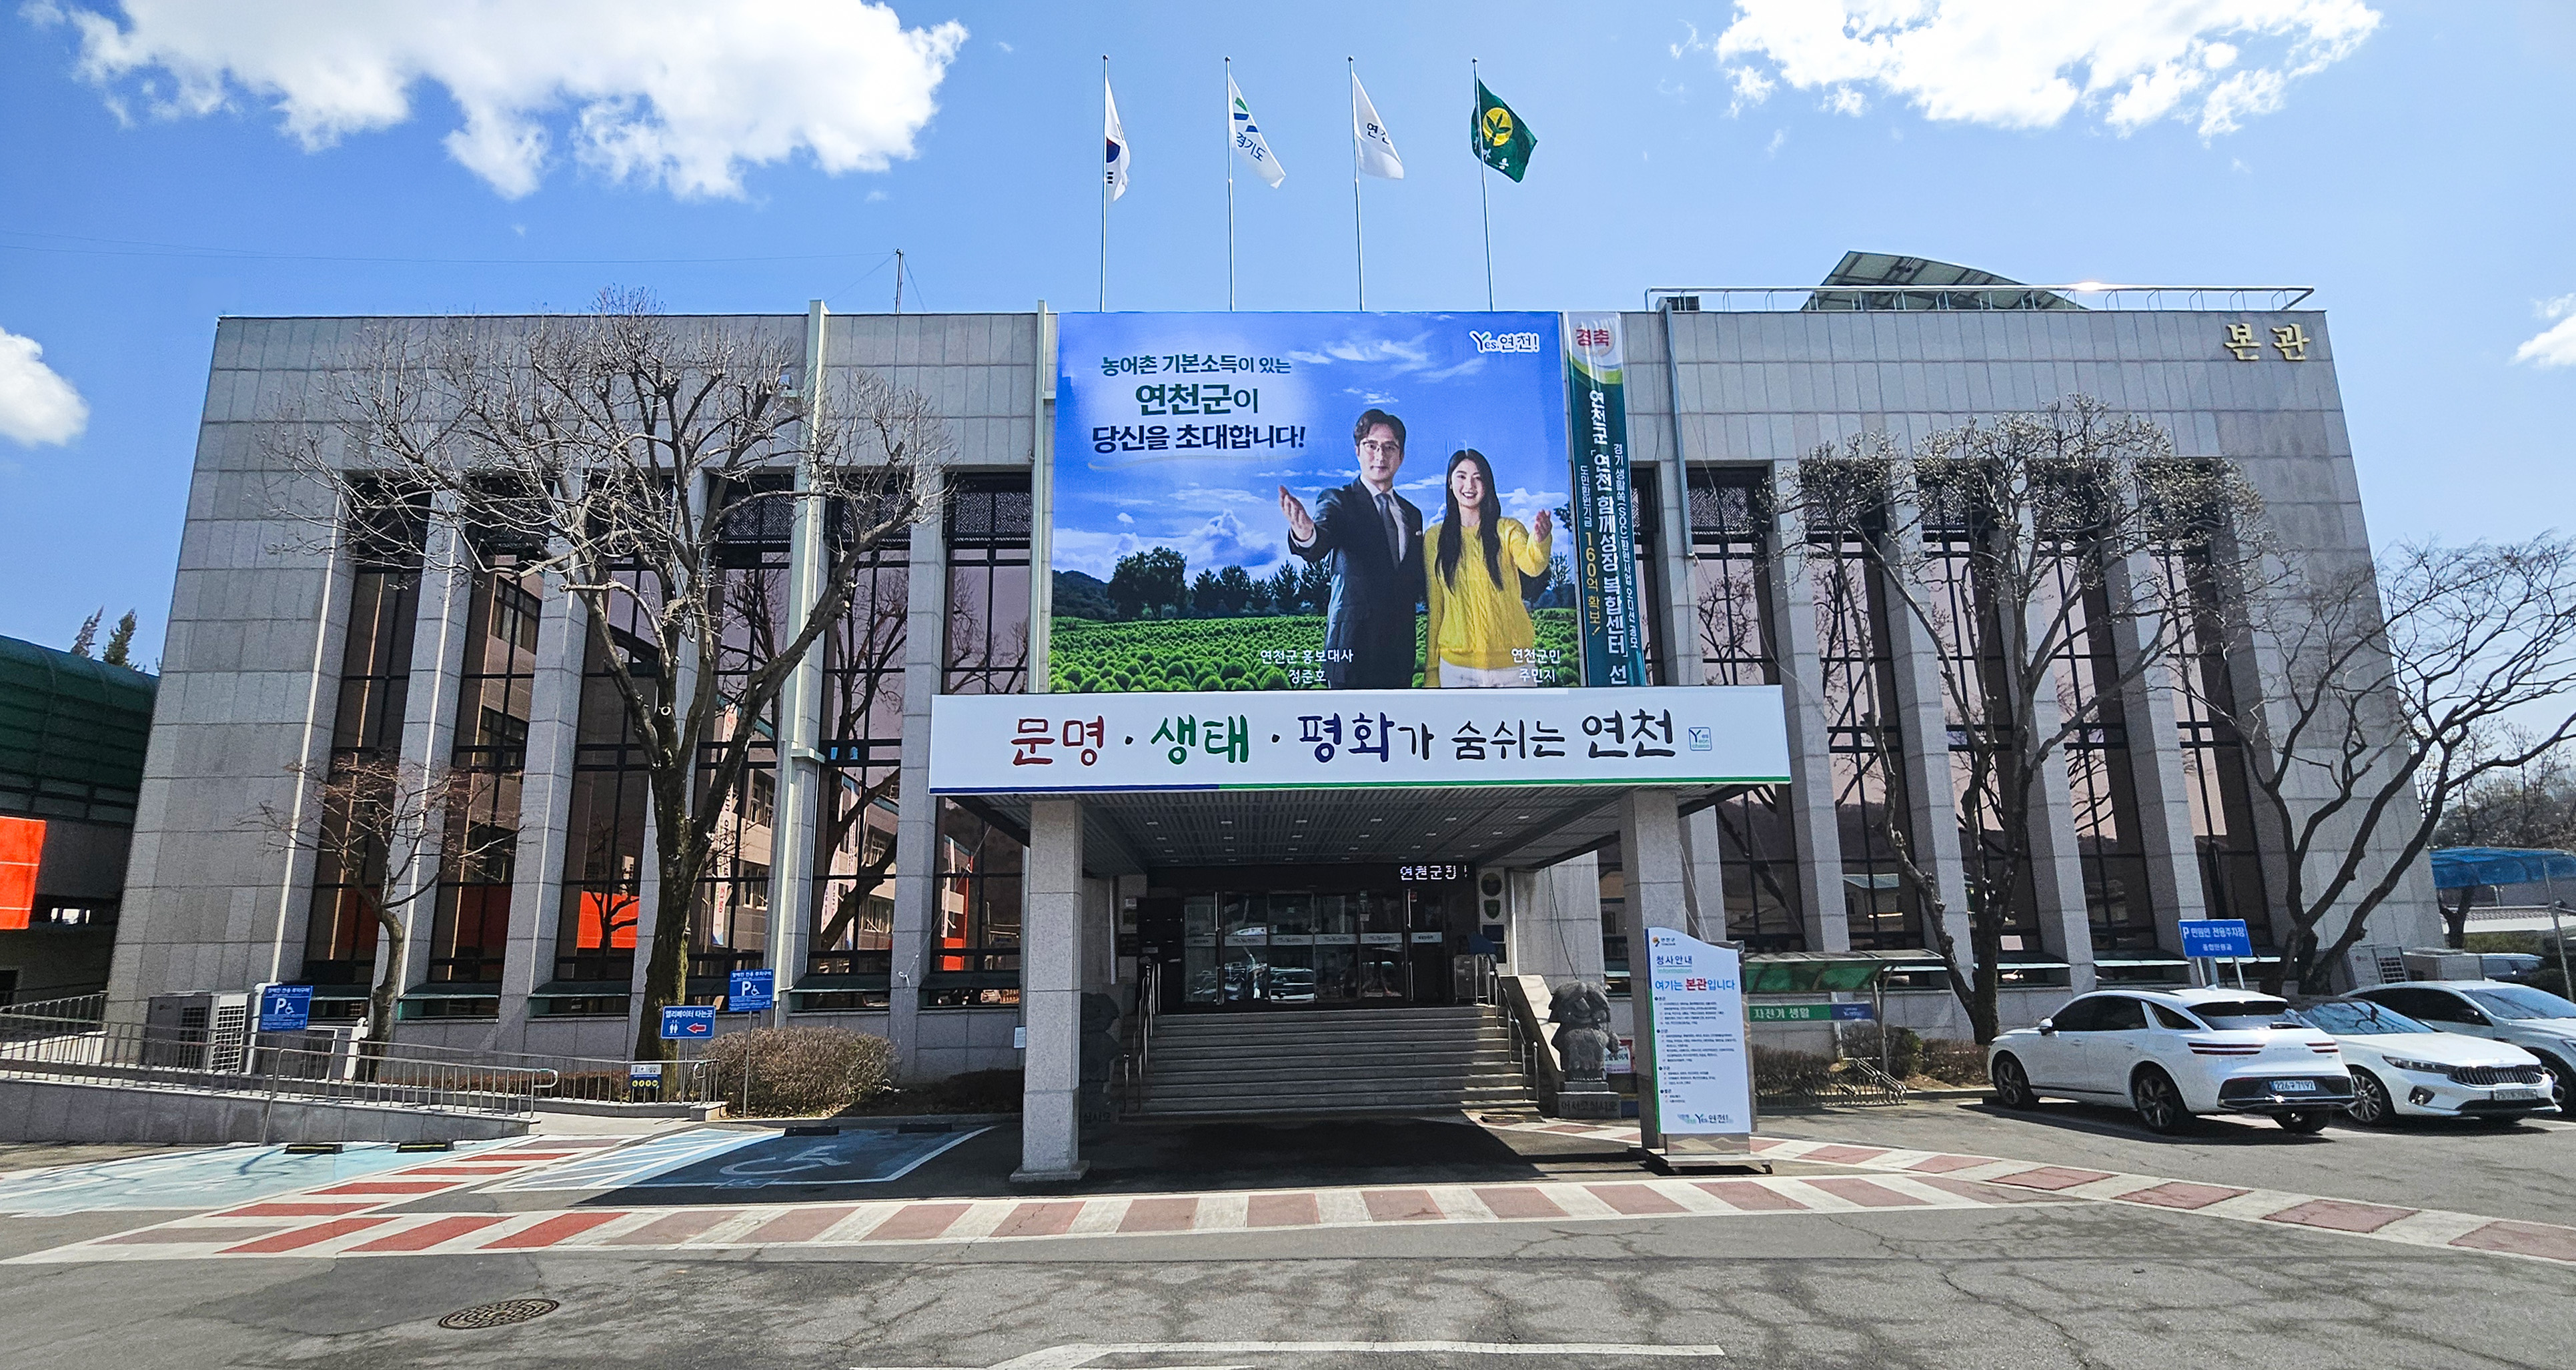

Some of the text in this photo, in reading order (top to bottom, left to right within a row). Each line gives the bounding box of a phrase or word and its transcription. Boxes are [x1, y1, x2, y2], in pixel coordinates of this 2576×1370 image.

[1237, 132, 1266, 162] 경기도
[1575, 328, 1609, 346] 경축
[2224, 323, 2311, 360] 본관
[1101, 354, 1291, 376] 농어촌 기본소득이 있는
[1135, 383, 1258, 416] 연천군이
[1589, 390, 1608, 445] 연천군
[1092, 424, 1306, 454] 당신을 초대합니다!
[1614, 444, 1624, 466] 경기
[1596, 495, 1618, 572] 함께성장
[1585, 532, 1598, 592] 160억
[1587, 595, 1601, 636] 확보!
[1260, 649, 1354, 664] 연천군 홍보대사
[1510, 648, 1561, 664] 연천군민
[1288, 669, 1327, 685] 정준호
[1519, 668, 1556, 684] 주민지
[1609, 664, 1628, 685] 선
[1011, 715, 1104, 766] 문명
[1151, 714, 1249, 765] 생태
[1298, 712, 1435, 763] 평화가
[1451, 720, 1565, 761] 숨쉬는
[1581, 708, 1676, 759] 연천
[1656, 955, 1693, 965] 청사안내
[1655, 978, 1735, 991] 여기는 본관입니다
[665, 1009, 713, 1018] 엘리베이터 타는곳
[1754, 1008, 1785, 1019] 자전거
